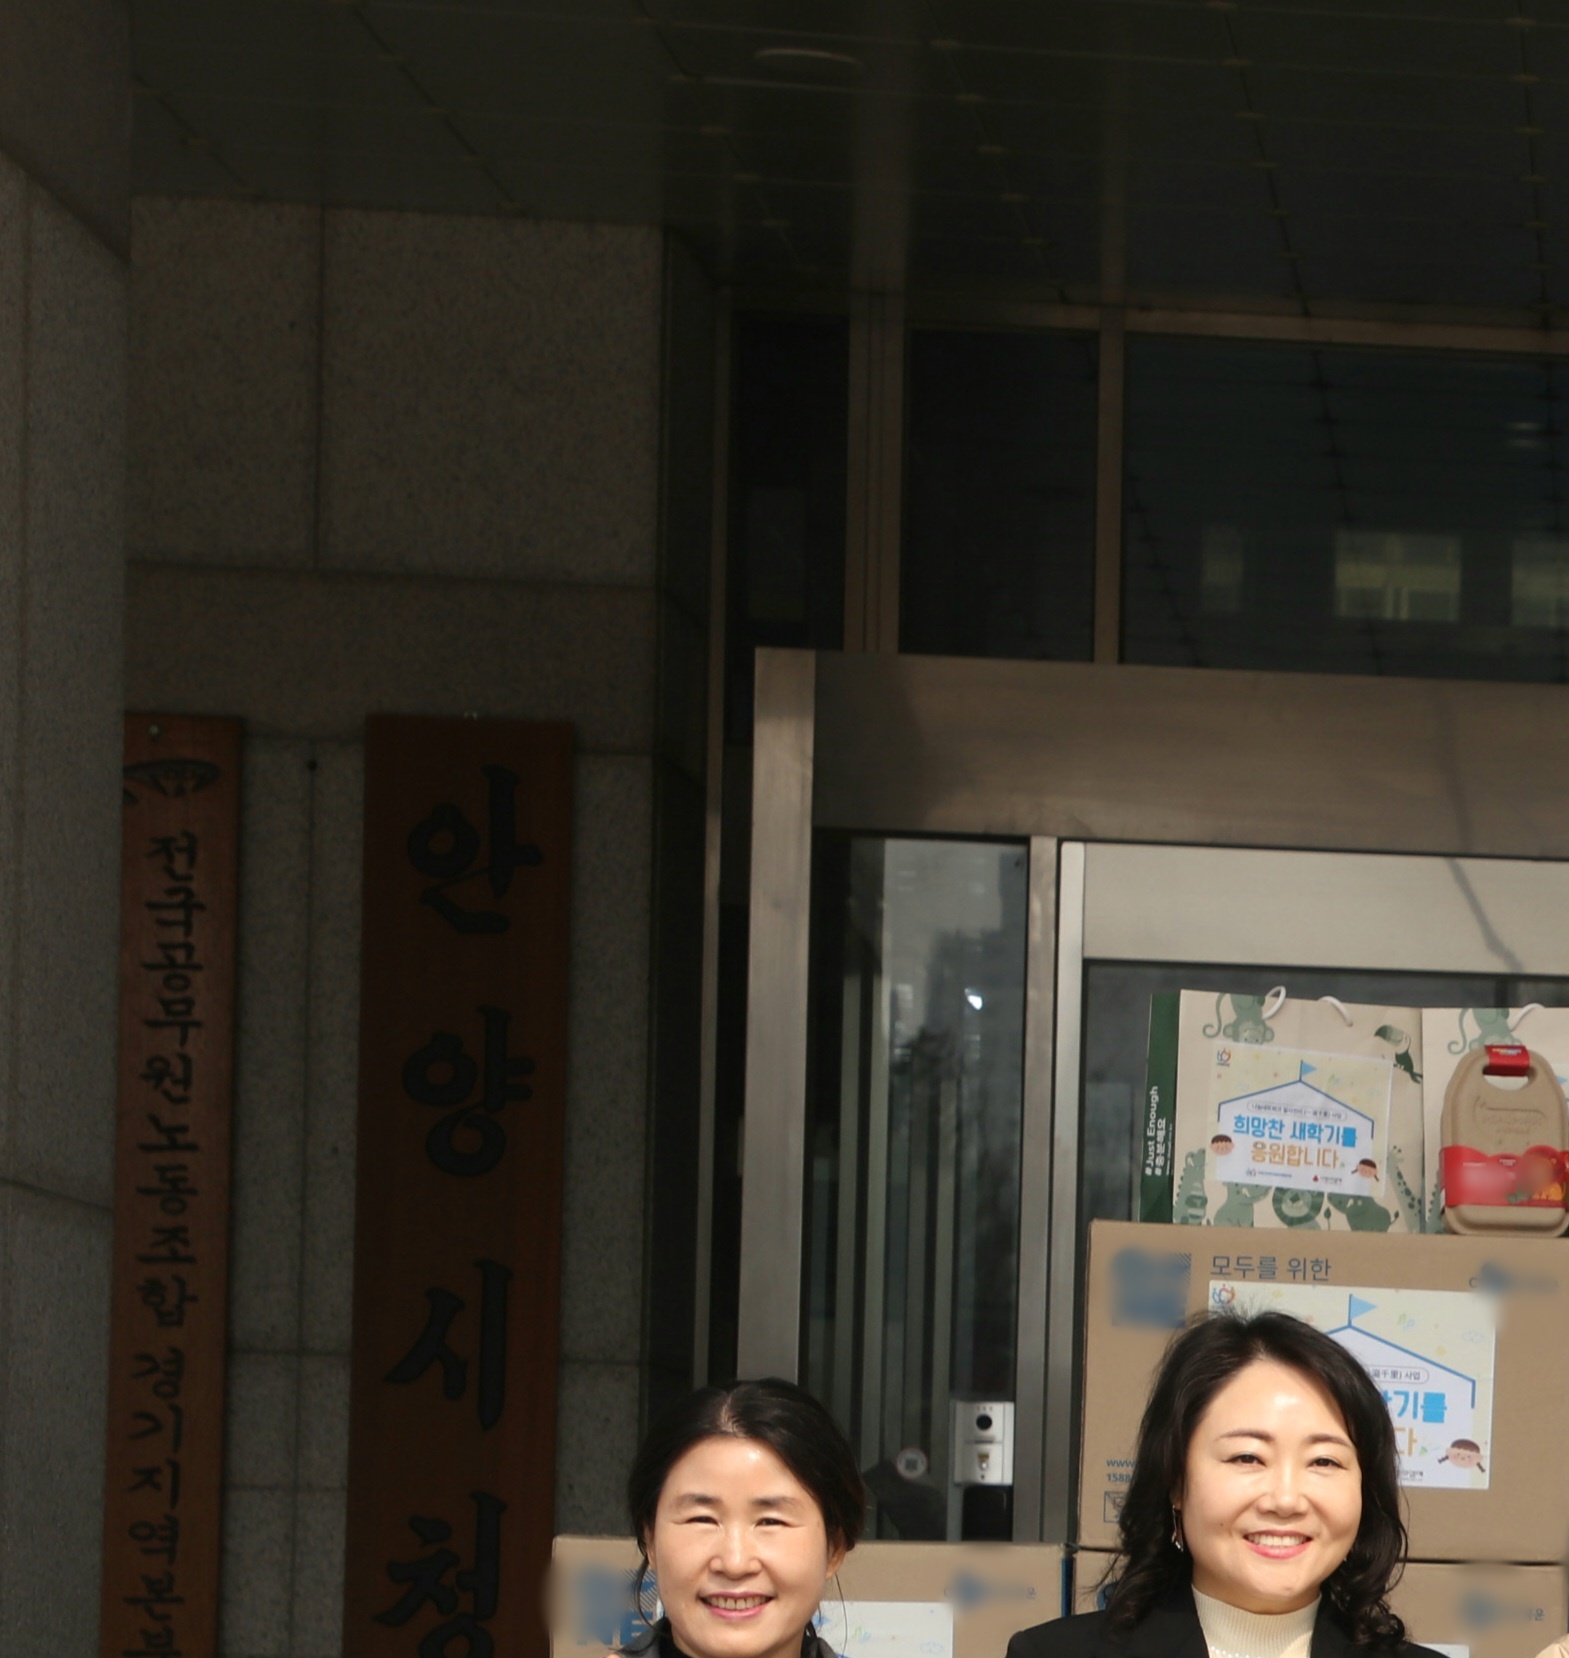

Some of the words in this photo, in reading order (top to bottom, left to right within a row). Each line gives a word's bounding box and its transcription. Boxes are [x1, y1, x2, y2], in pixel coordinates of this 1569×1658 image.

[135, 829, 205, 1328] 전국공무원노동조합
[1146, 1085, 1159, 1137] Enough
[1233, 1114, 1285, 1141] 희망찬
[1290, 1121, 1358, 1148] 새학기를
[1251, 1141, 1339, 1169] 응원합니다
[1210, 1254, 1278, 1280] 모두를
[1286, 1257, 1332, 1282] 위한
